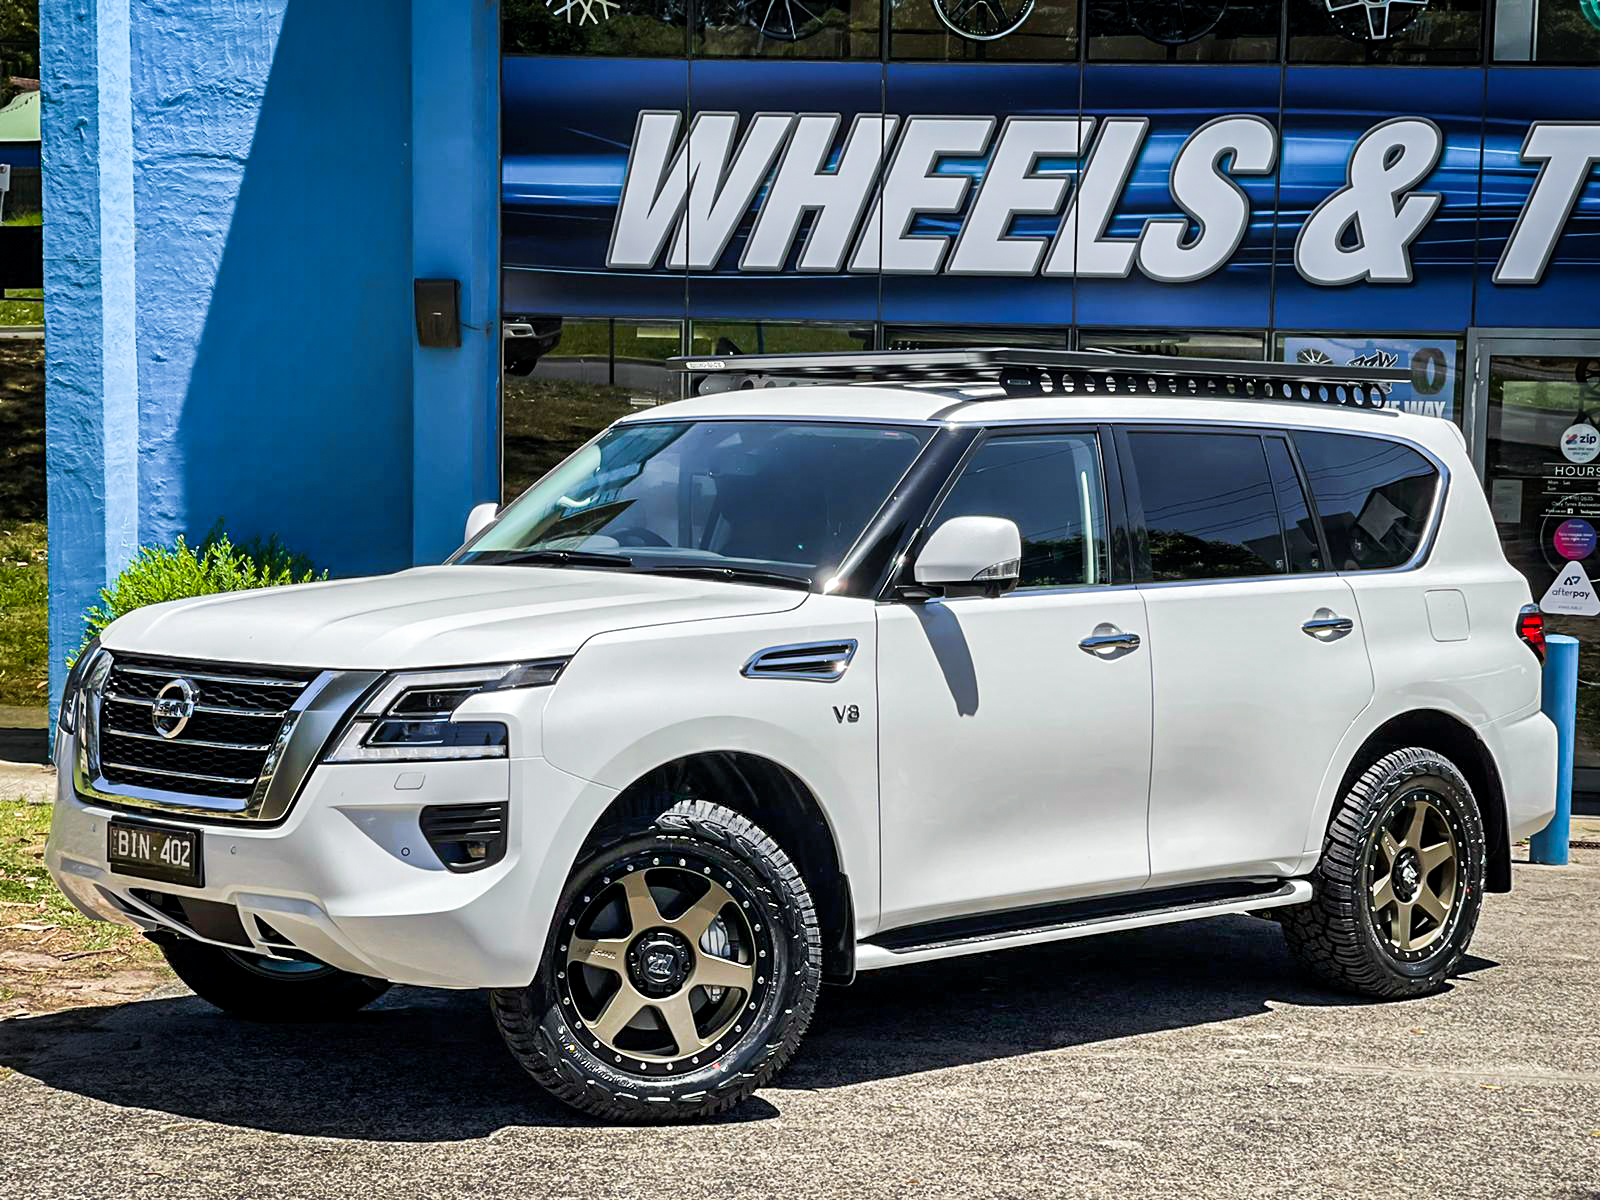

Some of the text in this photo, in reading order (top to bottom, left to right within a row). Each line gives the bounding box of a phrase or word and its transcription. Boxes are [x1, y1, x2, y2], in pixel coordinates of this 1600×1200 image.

[606, 110, 1600, 287] WHEELS & T
[1579, 434, 1597, 445] zip
[1551, 587, 1590, 600] afterpay
[832, 704, 860, 724] V8
[119, 830, 190, 868] BIN 402
